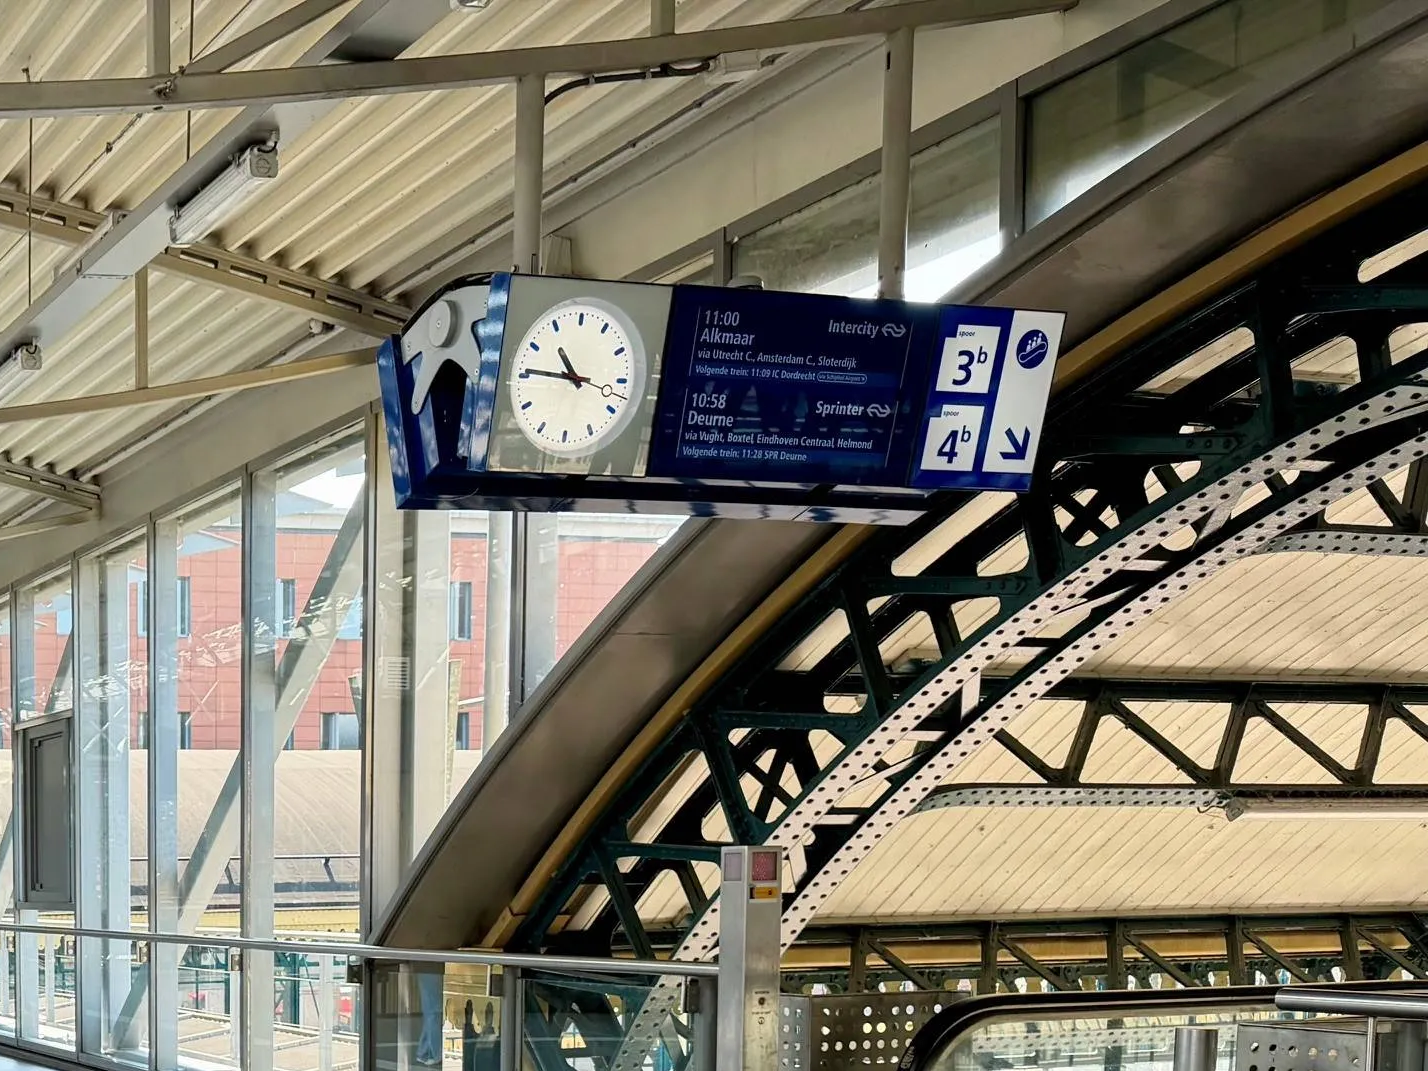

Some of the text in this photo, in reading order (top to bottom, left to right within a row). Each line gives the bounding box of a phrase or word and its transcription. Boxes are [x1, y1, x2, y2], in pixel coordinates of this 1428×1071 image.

[704, 309, 740, 327] 11:00
[700, 327, 756, 347] Alkmaar
[827, 319, 879, 339] Intercity
[698, 349, 711, 360] via
[712, 348, 744, 362] Utrecht
[757, 353, 804, 366] Amsterdam
[818, 355, 857, 371] Sloterdijk
[695, 364, 816, 381] Volgende trein: 11:09 IC Dordrecht
[691, 392, 727, 409] 10:58
[815, 400, 864, 417] Sprinter
[687, 410, 734, 427] Deurne
[685, 430, 698, 441] via
[699, 431, 725, 445] Vught,
[756, 434, 799, 447] Eindhoven
[837, 438, 873, 450] Helmond
[682, 446, 807, 462] Volgende trein: 11:28 SPR Deurne
